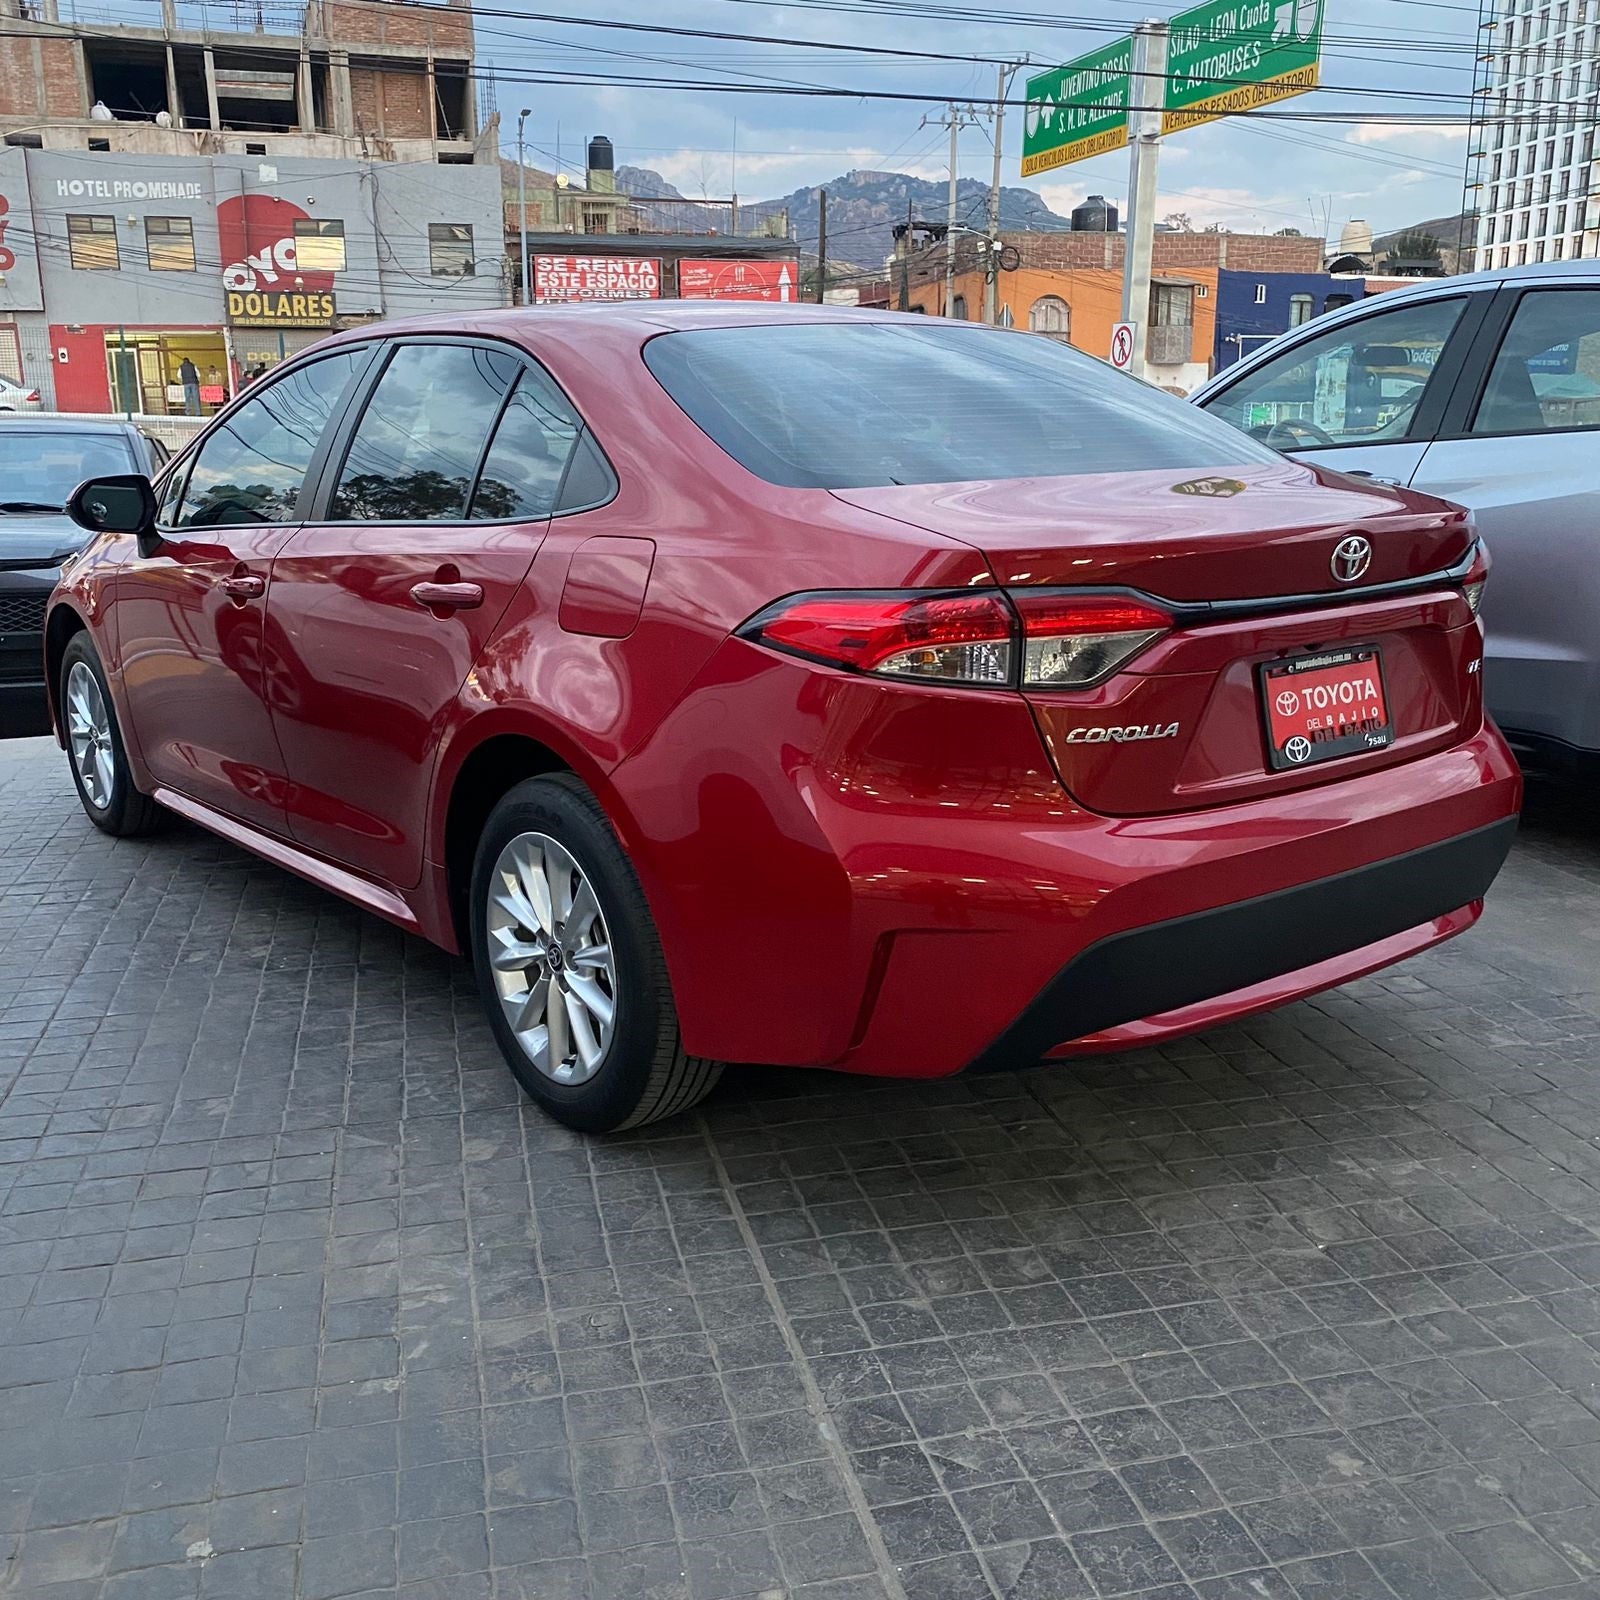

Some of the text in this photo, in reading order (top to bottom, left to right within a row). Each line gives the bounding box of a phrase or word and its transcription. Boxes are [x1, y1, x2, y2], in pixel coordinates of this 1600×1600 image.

[1170, 24, 1200, 58] SILAO
[1209, 8, 1237, 42] LEON
[1240, 0, 1270, 31] Cuota
[1058, 52, 1129, 102] JUVENTINO ROSAS
[1187, 41, 1261, 90] AUTOBUSES
[1211, 88, 1251, 113] PESADOS
[1252, 68, 1314, 103] OBLIGATORIO
[1077, 105, 1087, 128] DE
[1088, 90, 1124, 124] ALLENDE
[56, 179, 202, 200] HOTEL PROMENADE
[537, 257, 654, 274] SE RENTA
[537, 271, 657, 289] ESTE ESPACIO
[228, 292, 334, 318] DOLARES
[543, 288, 652, 299] INFORMES
[1301, 678, 1378, 710] TOYOTA
[1065, 721, 1180, 743] COROLLA
[1306, 718, 1322, 730] DEL
